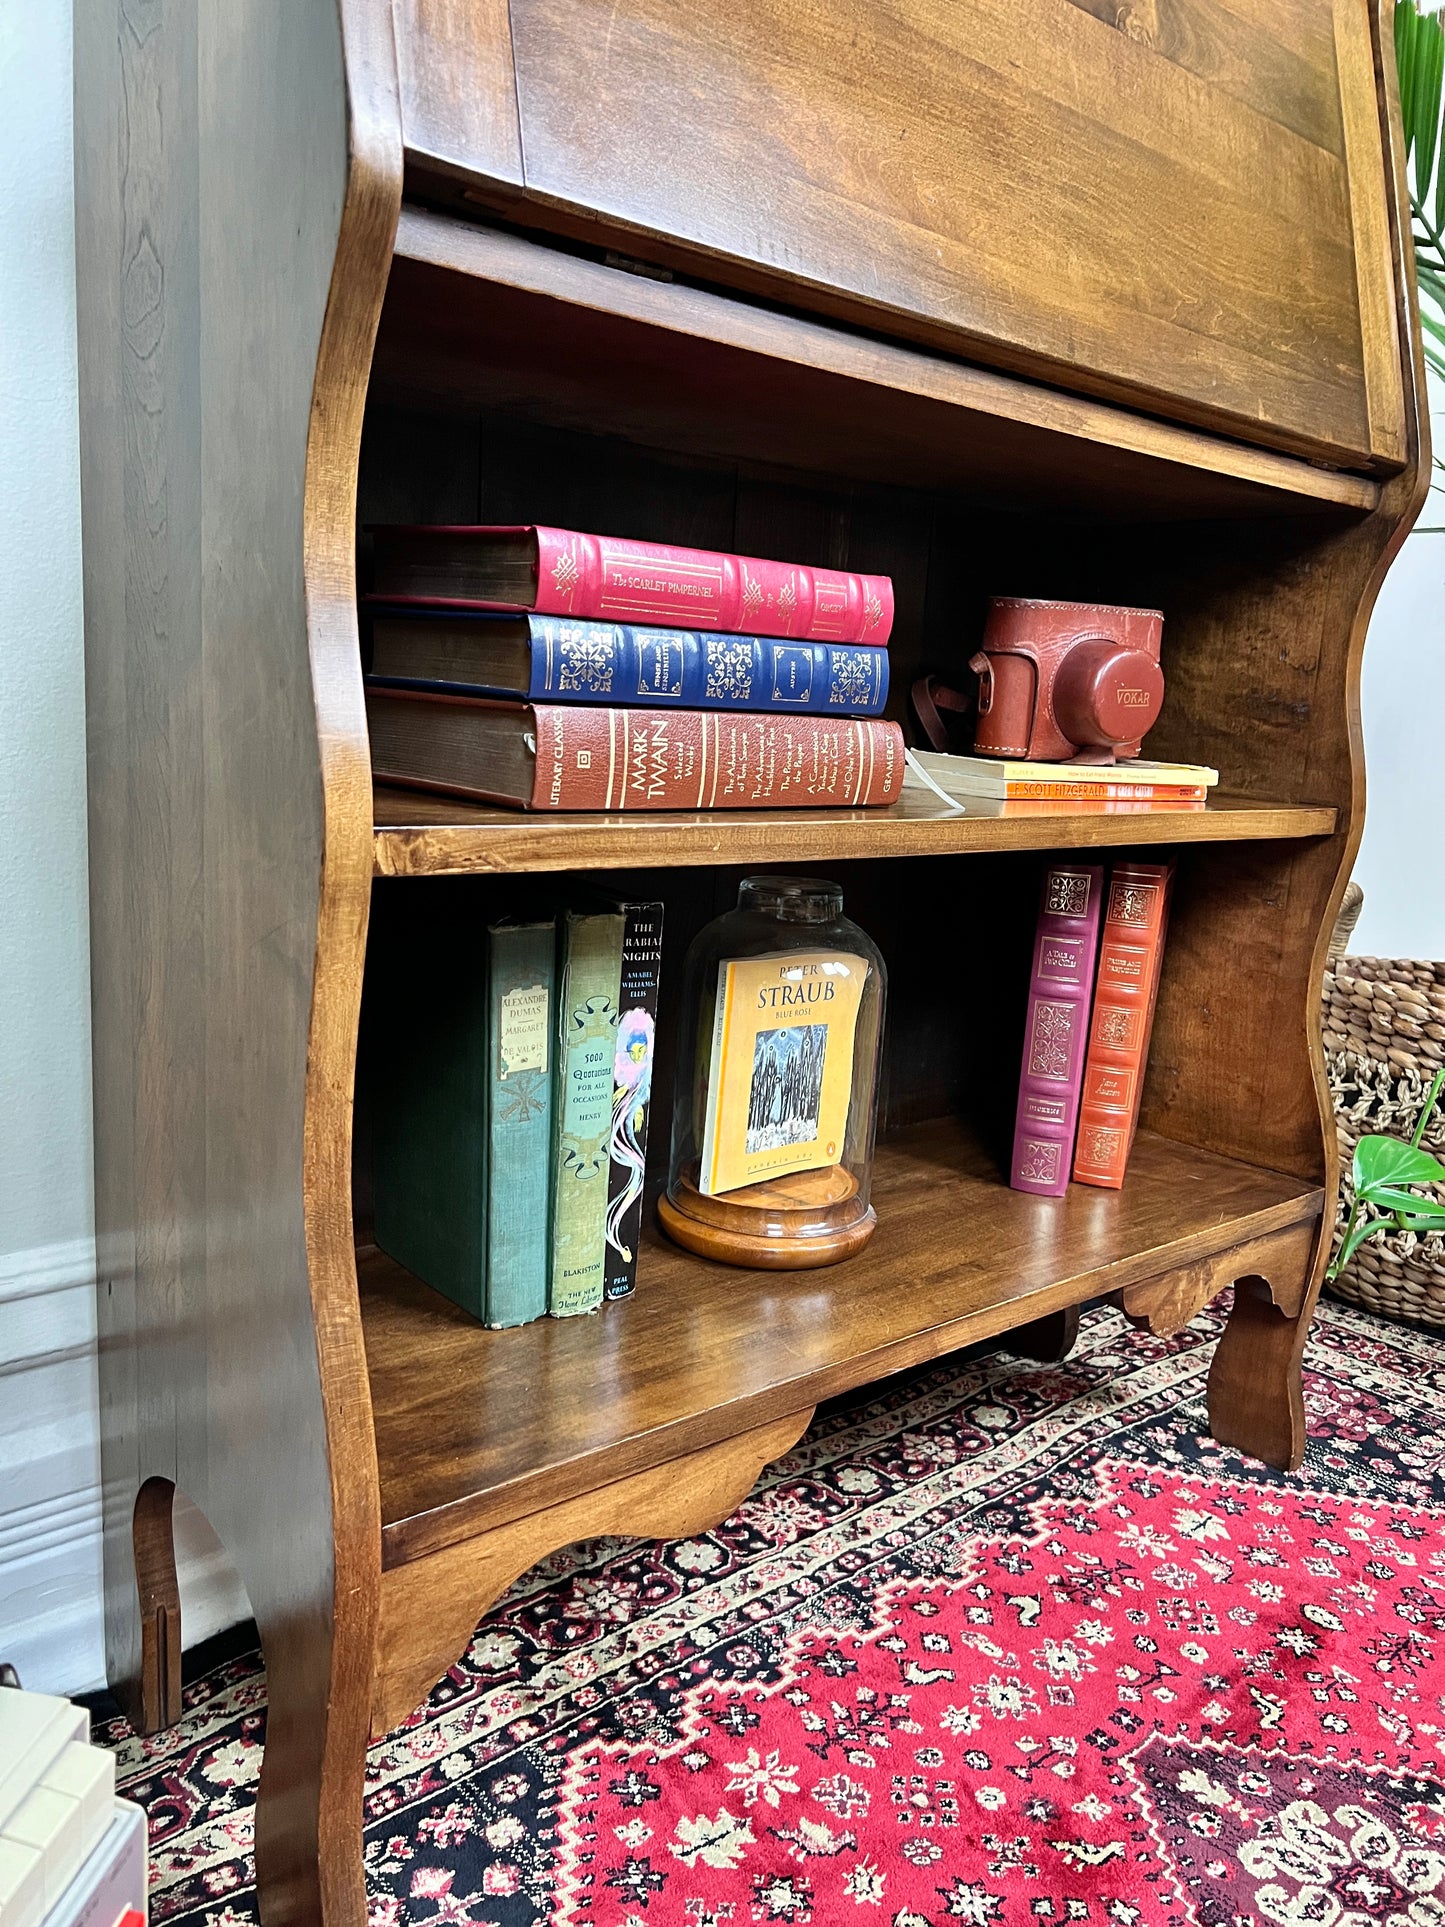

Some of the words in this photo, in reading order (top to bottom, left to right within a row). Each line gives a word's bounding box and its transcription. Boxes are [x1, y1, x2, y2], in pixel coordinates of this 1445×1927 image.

[628, 576, 667, 592] SCARLET
[667, 582, 714, 598] PIMPERNEL
[1117, 690, 1150, 705] VOKAR
[552, 708, 564, 759] CLASSICS
[755, 723, 765, 733] of
[766, 727, 775, 746] Finn
[783, 733, 793, 749] and
[820, 733, 830, 754] King
[846, 727, 854, 756] Works
[726, 728, 737, 776] Adventures
[739, 732, 749, 762] Sawyer
[830, 733, 839, 758] Court
[631, 728, 648, 791] MARK
[647, 720, 669, 800] TWAIN
[674, 742, 685, 780] Selected
[685, 745, 695, 777] Works
[755, 735, 765, 782] Adventures
[783, 751, 793, 774] Prince
[794, 743, 805, 768] Pauper
[809, 731, 819, 782] Connecticut
[824, 756, 829, 764] in
[883, 733, 894, 793] GRAMERCY
[737, 763, 747, 781] Tom
[763, 749, 777, 797] Huckleberry
[793, 770, 802, 783] the
[844, 757, 854, 782] Other
[549, 761, 564, 806] LITERARY
[780, 775, 791, 791] The
[817, 765, 828, 792] Yankee
[724, 778, 735, 795] The
[737, 782, 745, 792] of
[751, 784, 762, 800] The
[807, 784, 816, 794] A
[843, 784, 851, 799] and
[1023, 783, 1052, 796] SCOTT
[1055, 784, 1105, 797] FITZGERALD
[634, 923, 654, 932] THE
[622, 952, 661, 961] NIGHTS
[627, 971, 652, 979] AMABEL
[502, 993, 547, 1007] ALEXANDRE
[630, 990, 647, 998] ELLIS
[757, 981, 835, 1009] STRAUB
[510, 1006, 542, 1018] DUMAS
[775, 1011, 793, 1019] BLUE
[794, 1009, 811, 1017] ROSE
[505, 1022, 544, 1035] MARGARET
[503, 1047, 514, 1056] DE
[517, 1043, 544, 1054] VALOIS
[584, 1052, 603, 1064] 5000
[573, 1067, 612, 1080] Quotations
[577, 1084, 592, 1092] FOR
[594, 1082, 606, 1090] ALL
[1101, 1077, 1118, 1088] Jane
[572, 1093, 608, 1104] OCCASIONS
[1095, 1087, 1121, 1097] Austen
[579, 1112, 601, 1121] HENRY
[563, 1262, 601, 1277] BLAKISTON
[568, 1291, 581, 1299] THE
[584, 1286, 596, 1295] NEW
[611, 1284, 629, 1295] PRESS
